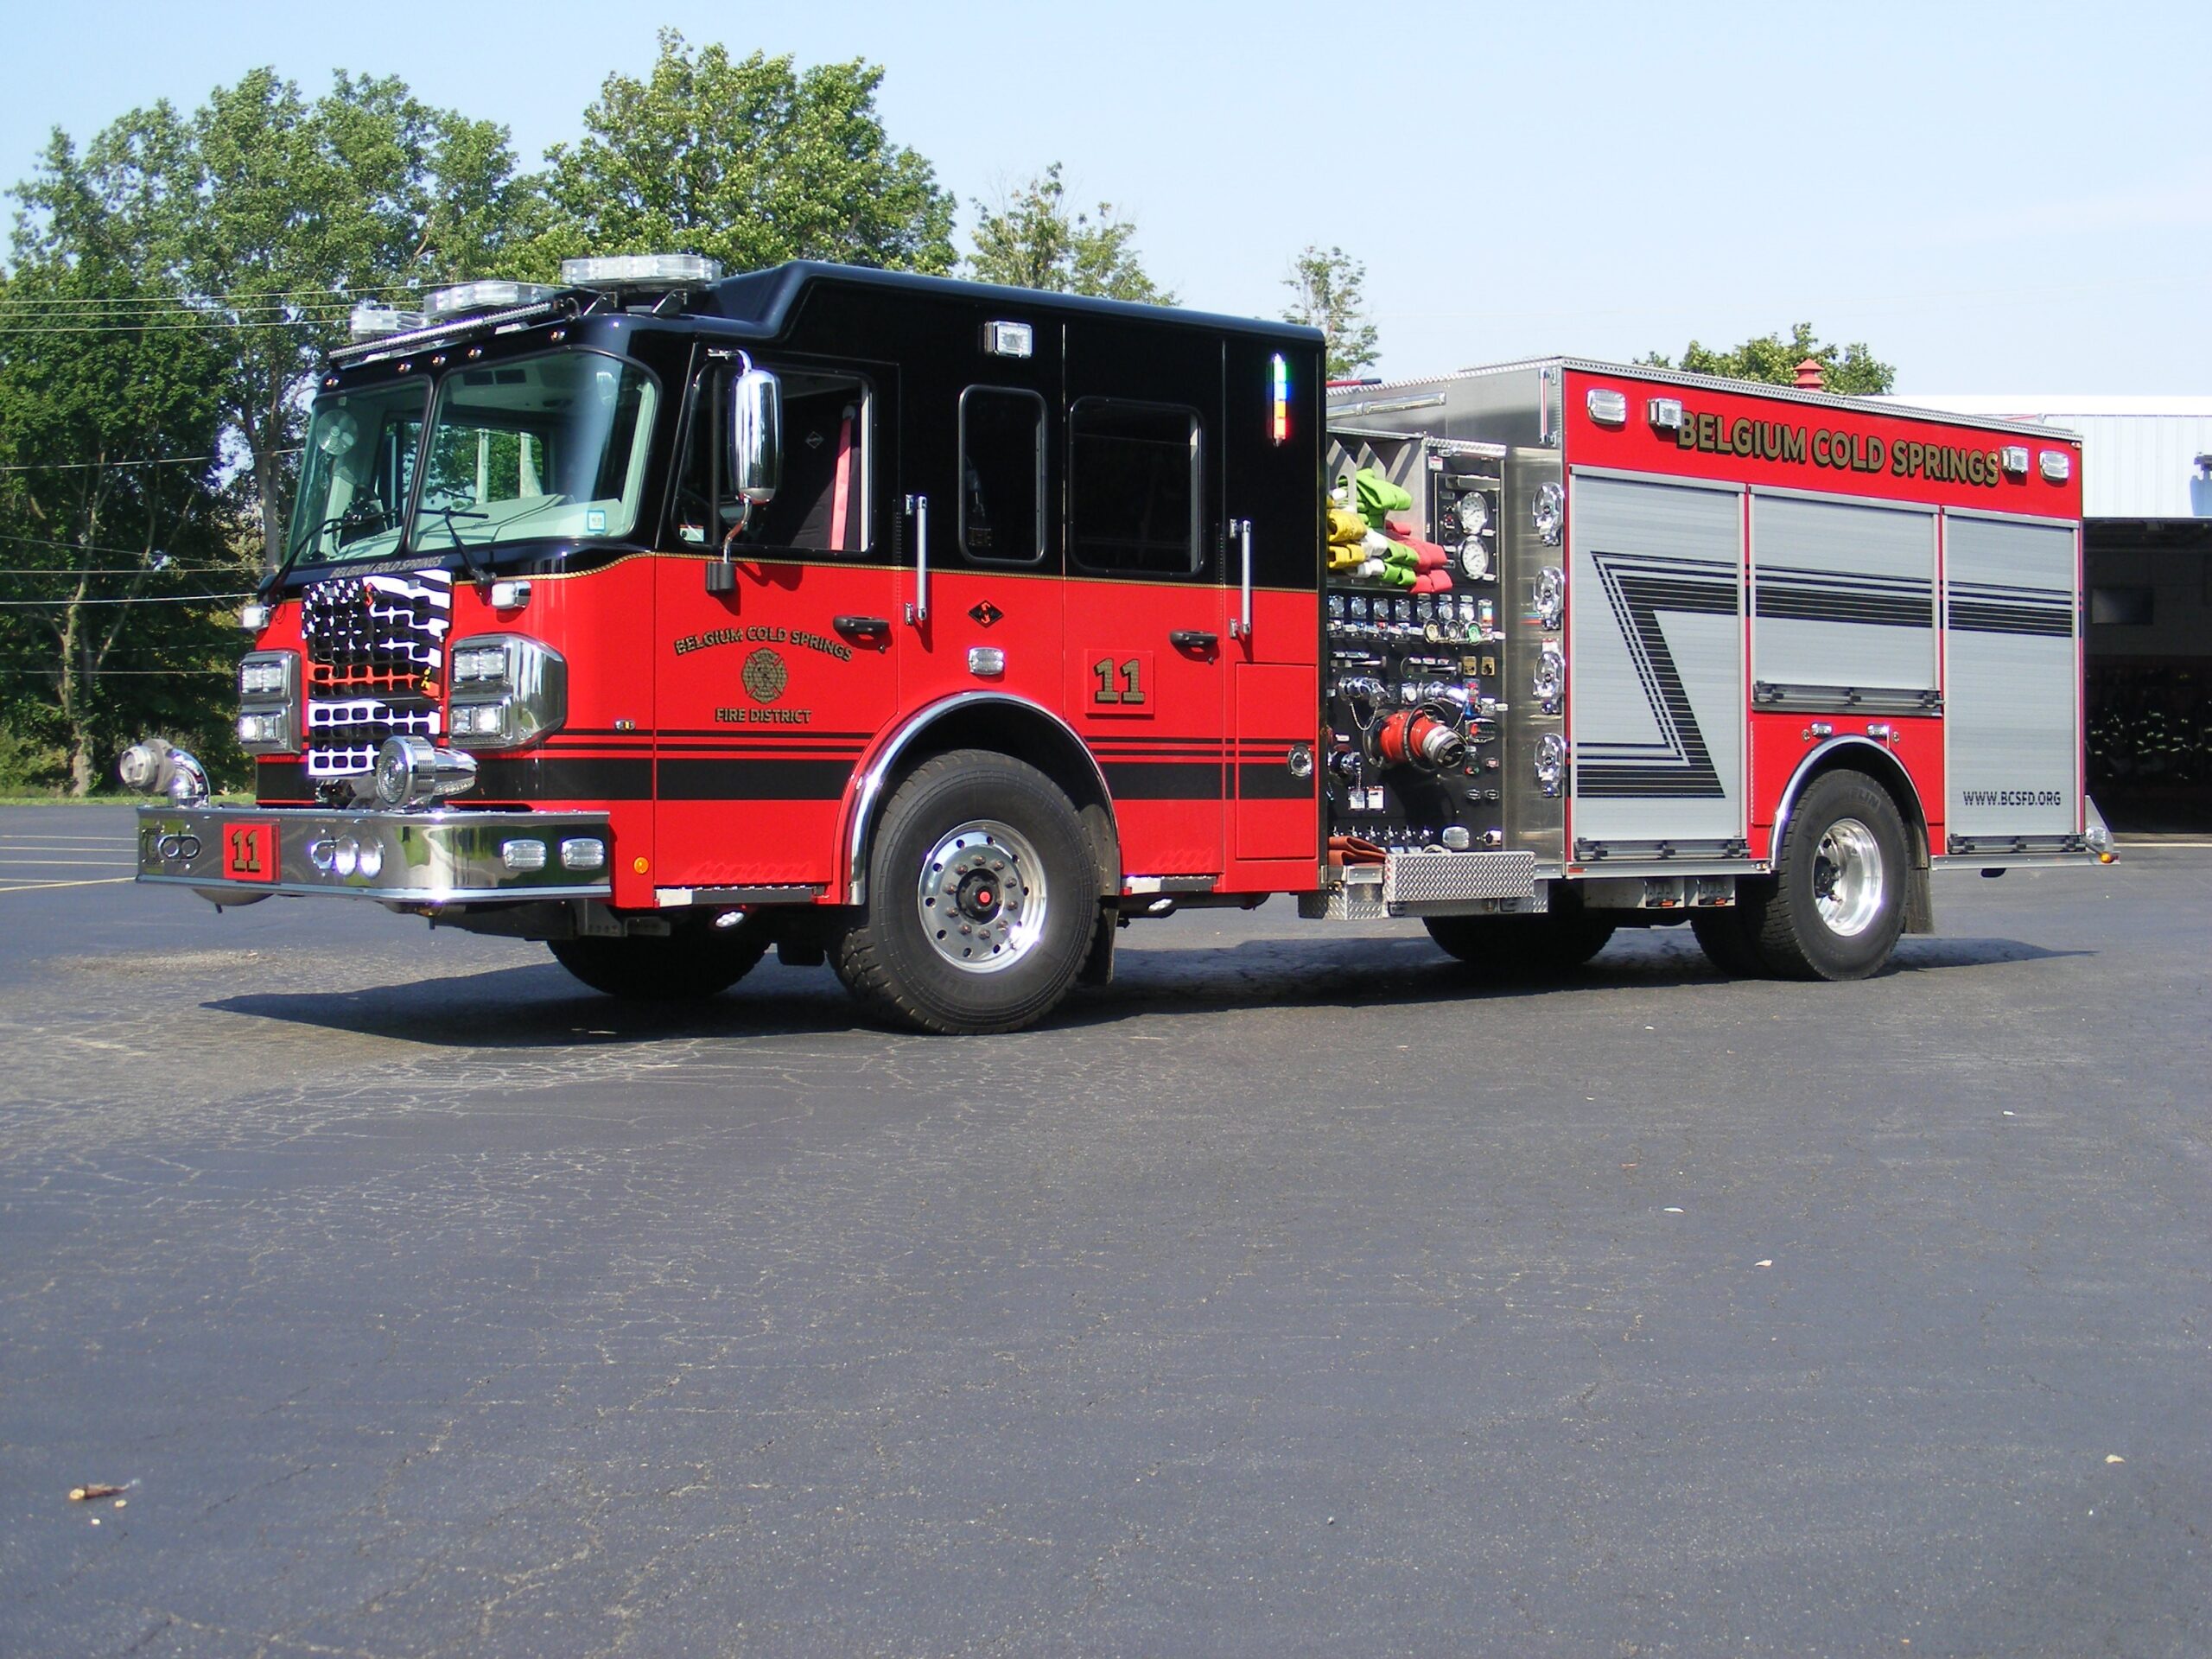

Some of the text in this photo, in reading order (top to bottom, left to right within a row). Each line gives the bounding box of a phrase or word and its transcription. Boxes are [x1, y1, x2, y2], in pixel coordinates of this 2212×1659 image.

[1676, 410, 1999, 486] BELGIUM COLD SPRINGS
[400, 556, 445, 570] SPRINGS
[674, 626, 853, 662] BELGIUM COLD SPRINGS
[1093, 658, 1145, 705] 11
[715, 708, 812, 724] FIRE DISTRICT
[1962, 791, 2062, 806] WWW.BCSFD.ORG
[232, 829, 262, 873] 11
